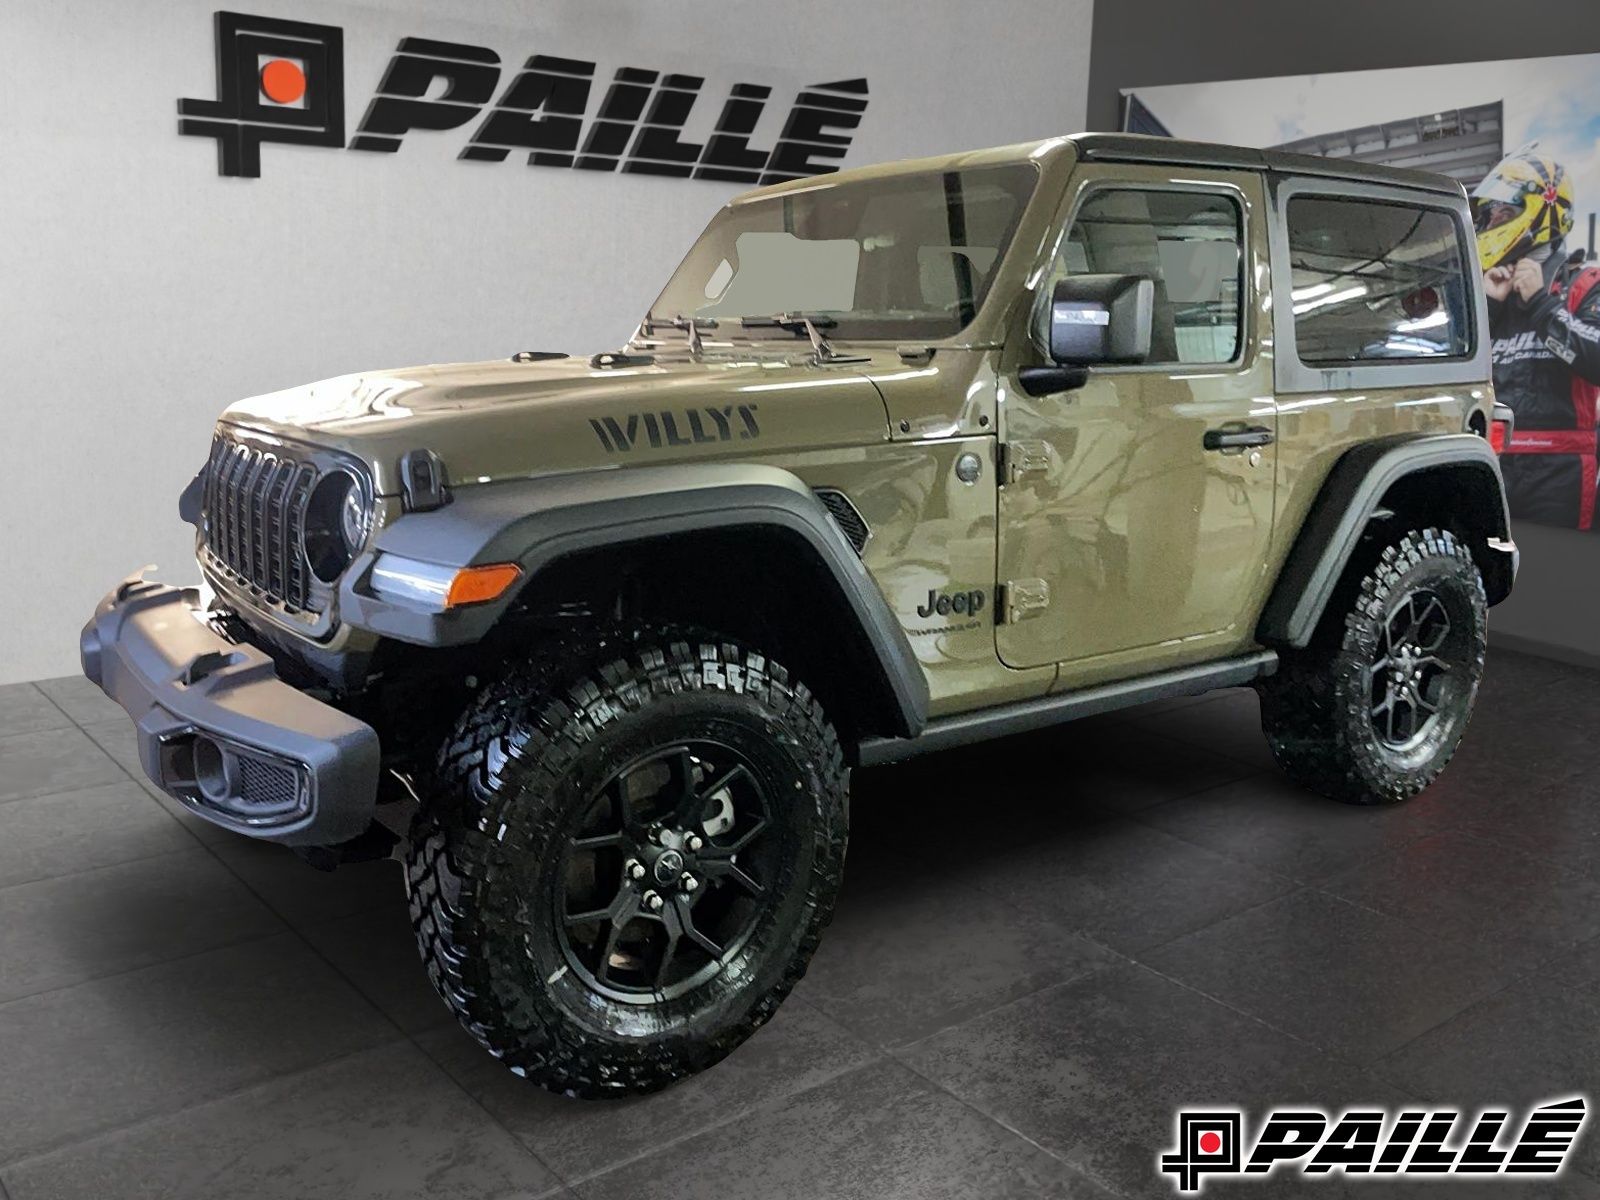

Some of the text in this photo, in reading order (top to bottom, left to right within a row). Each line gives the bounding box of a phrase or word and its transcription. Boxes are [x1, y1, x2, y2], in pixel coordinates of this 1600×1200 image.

[347, 37, 869, 185] PAILLÉ
[588, 404, 760, 452] WILLYS
[917, 589, 985, 618] Jeep
